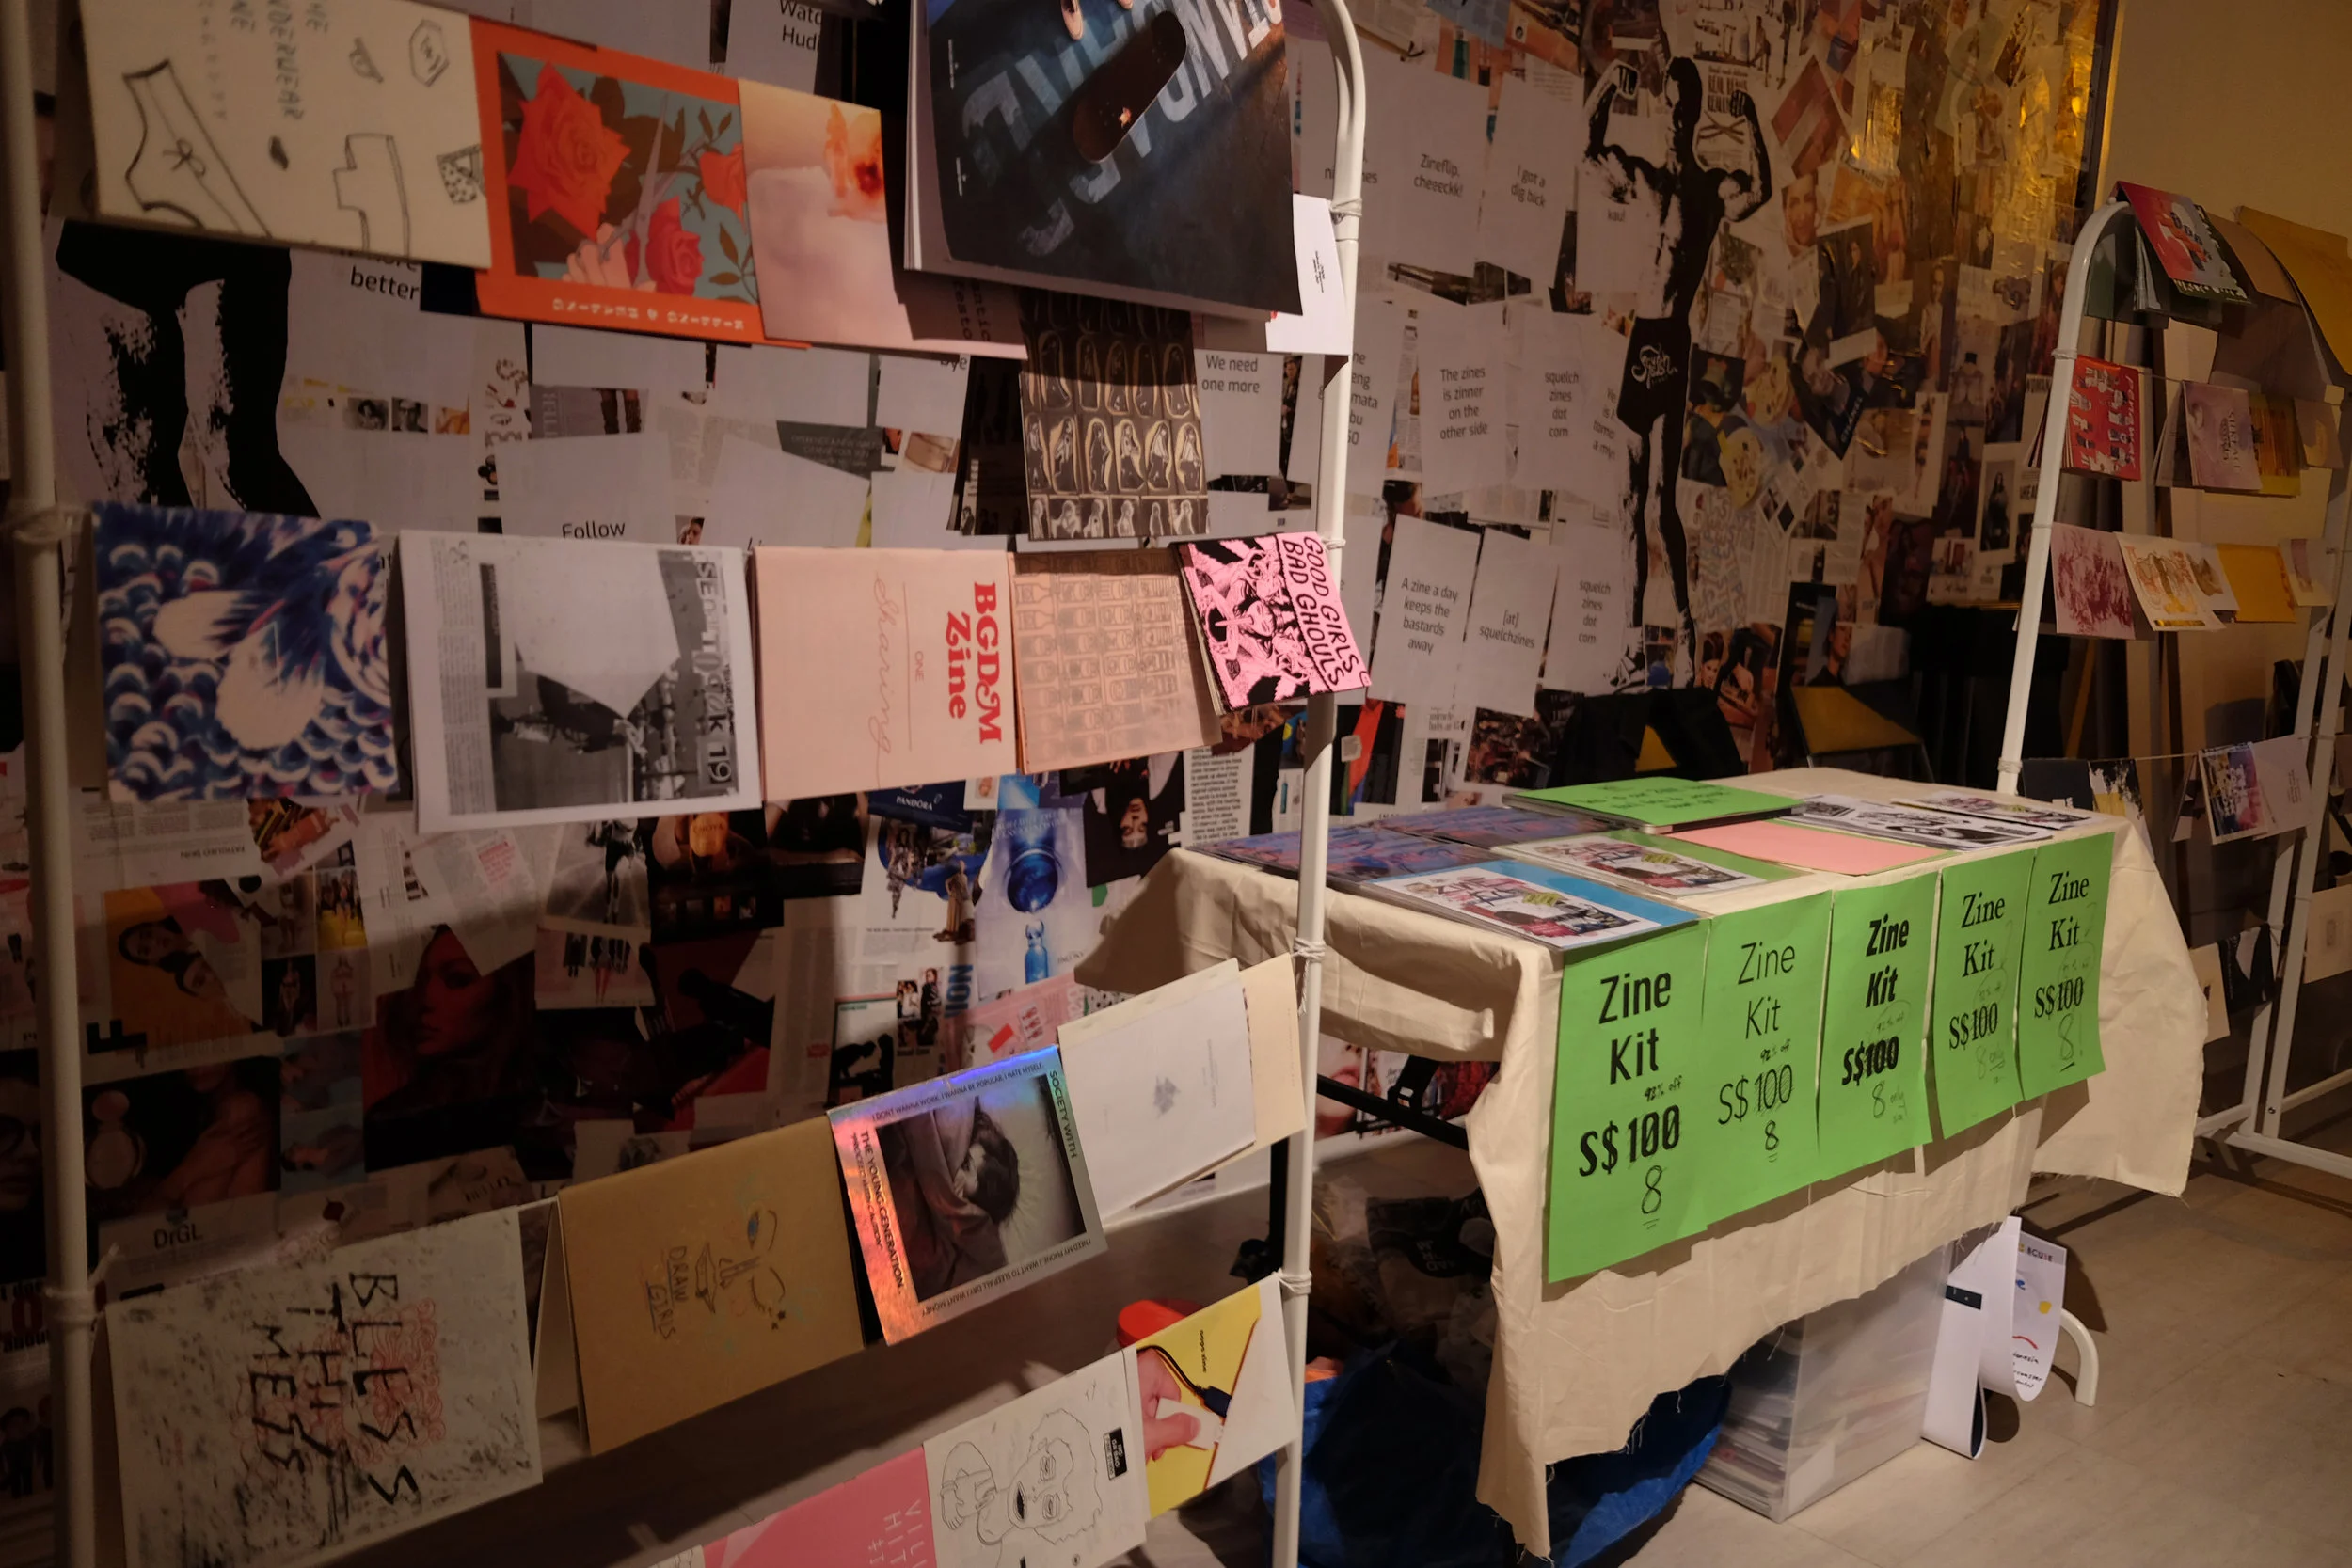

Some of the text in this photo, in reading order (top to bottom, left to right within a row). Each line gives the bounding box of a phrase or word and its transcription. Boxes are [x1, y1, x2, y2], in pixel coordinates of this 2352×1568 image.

[351, 264, 420, 300] better
[1205, 354, 1259, 372] We need
[1440, 366, 1486, 383] The zines
[1201, 378, 1260, 393] one more
[1544, 371, 1579, 385] squelch
[1443, 387, 1484, 402] is zinner
[1549, 390, 1572, 402] zines
[1448, 404, 1479, 420] on the
[1552, 409, 1567, 420] dot
[1440, 422, 1487, 440] other side
[1549, 427, 1568, 438] com
[1401, 577, 1458, 602] A zine a day
[1579, 579, 1611, 594] squelch
[1282, 540, 1344, 686] BAD GHOULS
[1304, 536, 1359, 673] GOOD GIRLS
[1404, 596, 1450, 618] keeps the
[1581, 598, 1603, 610] zines
[1403, 616, 1445, 636] bastards
[1502, 609, 1519, 627] [at]
[1582, 616, 1597, 627] dot
[1407, 637, 1434, 655] away
[1479, 625, 1535, 648] squelchzines
[1579, 633, 1597, 644] com
[914, 651, 924, 683] ONE
[946, 611, 971, 719] Zine
[974, 581, 1002, 744] BGDM
[896, 795, 934, 811] PANDORA
[2048, 870, 2090, 905] Zine
[1961, 891, 2006, 928] Zine
[1866, 913, 1910, 957] Zine
[2048, 916, 2081, 951] Kit
[1738, 941, 1795, 985] Zine
[1962, 939, 1995, 978] Kit
[1599, 972, 1672, 1024] Zine
[1866, 965, 1898, 1008] Kit
[2034, 976, 2084, 1019] S$100
[1745, 996, 1781, 1039] Kit
[1949, 1002, 1998, 1051] S$100
[1610, 1027, 1659, 1085] Kit
[1841, 1036, 1899, 1086] S$100
[896, 1101, 919, 1115] WANNA
[945, 1085, 967, 1099] WANNA
[968, 1084, 976, 1092] BE
[1007, 1069, 1022, 1080] HATE
[1872, 1081, 1886, 1119] 8
[1049, 1070, 1078, 1159] SOCIETY WITH
[1765, 1120, 1779, 1151] 8
[860, 1132, 875, 1155] THE
[868, 1155, 887, 1201] YOUNG
[1642, 1164, 1663, 1214] 8
[1063, 1247, 1073, 1257] MY
[1073, 1242, 1089, 1253] NEED
[669, 1245, 689, 1302] DRAW
[994, 1273, 1012, 1284] SLEEP
[1022, 1263, 1040, 1275] WANT
[983, 1278, 994, 1288] ALL
[921, 1298, 946, 1318] MONEY
[947, 1291, 967, 1305] WANT
[349, 1273, 421, 1505] BLESS
